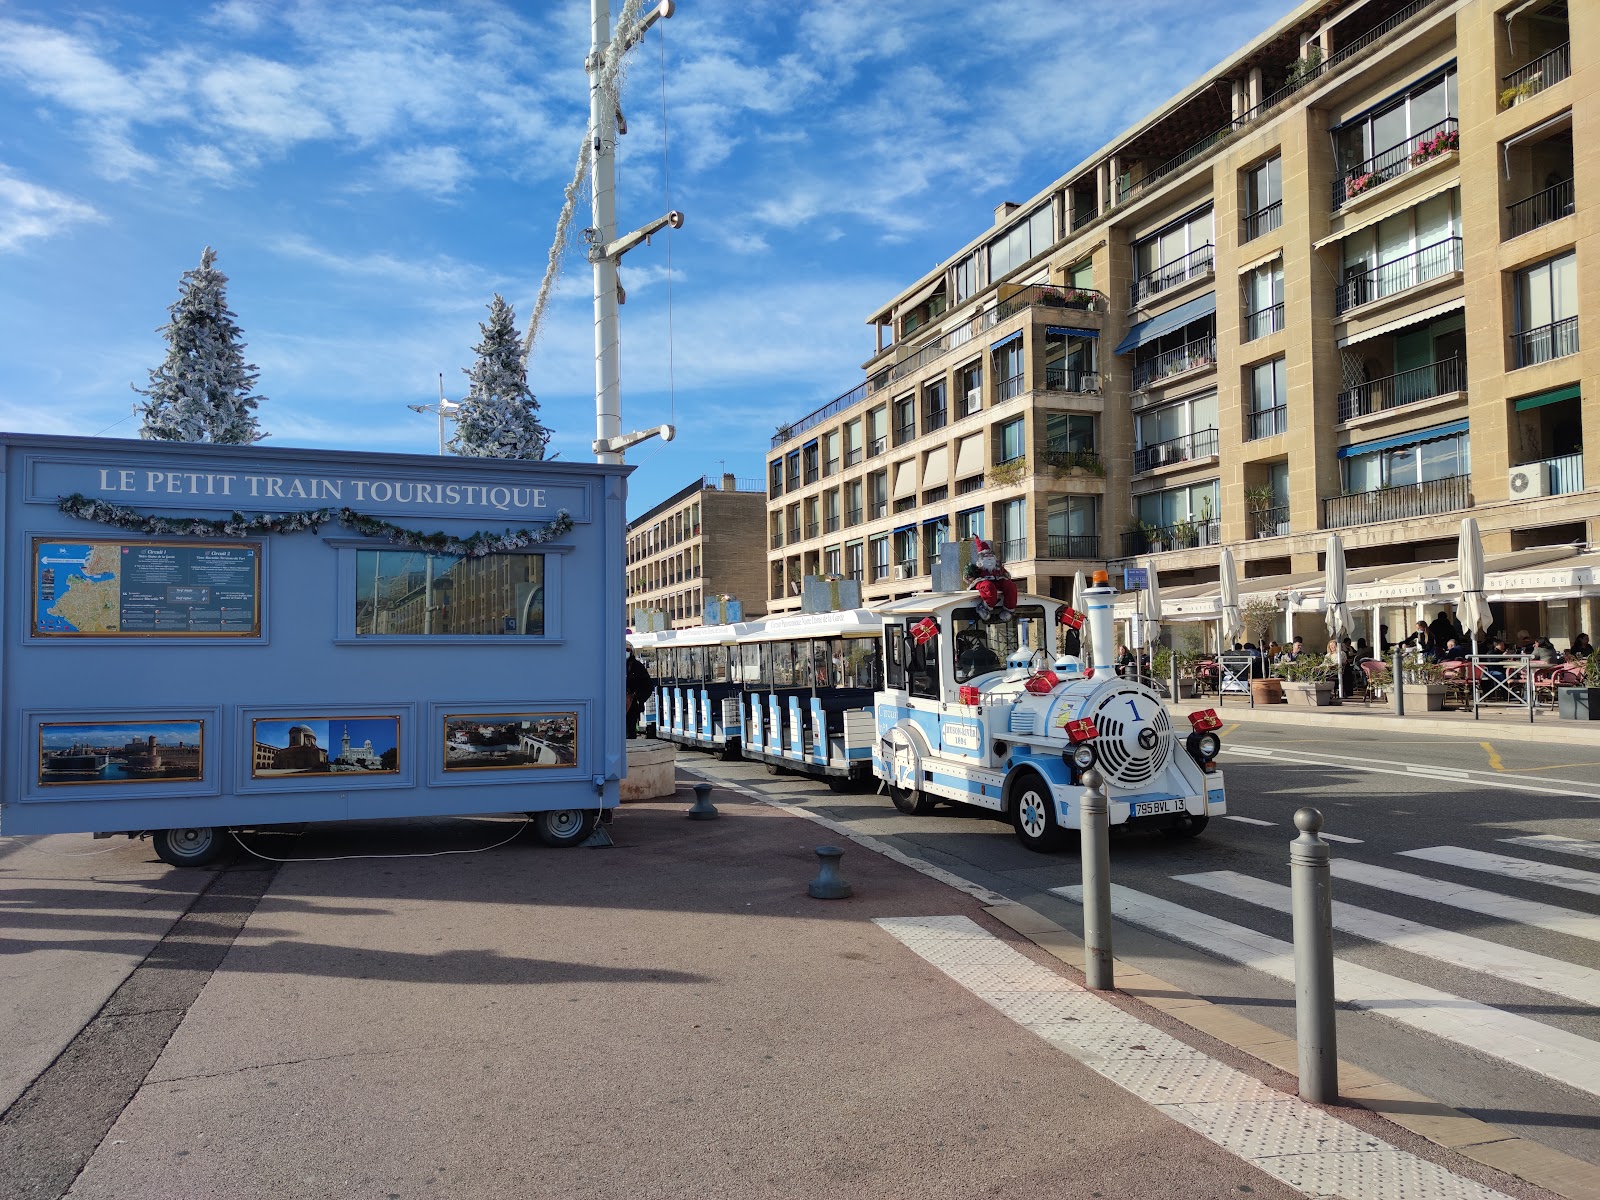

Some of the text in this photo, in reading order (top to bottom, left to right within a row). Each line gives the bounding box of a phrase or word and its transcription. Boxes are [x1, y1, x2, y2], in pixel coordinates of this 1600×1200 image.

[98, 469, 547, 511] LE PETIT TRAIN TOURISTIQUE
[1379, 584, 1442, 596] PROVENÇALE
[1490, 577, 1541, 587] BUFFETS
[1124, 699, 1146, 722] 1
[1136, 799, 1184, 815] 795 BVL 13
